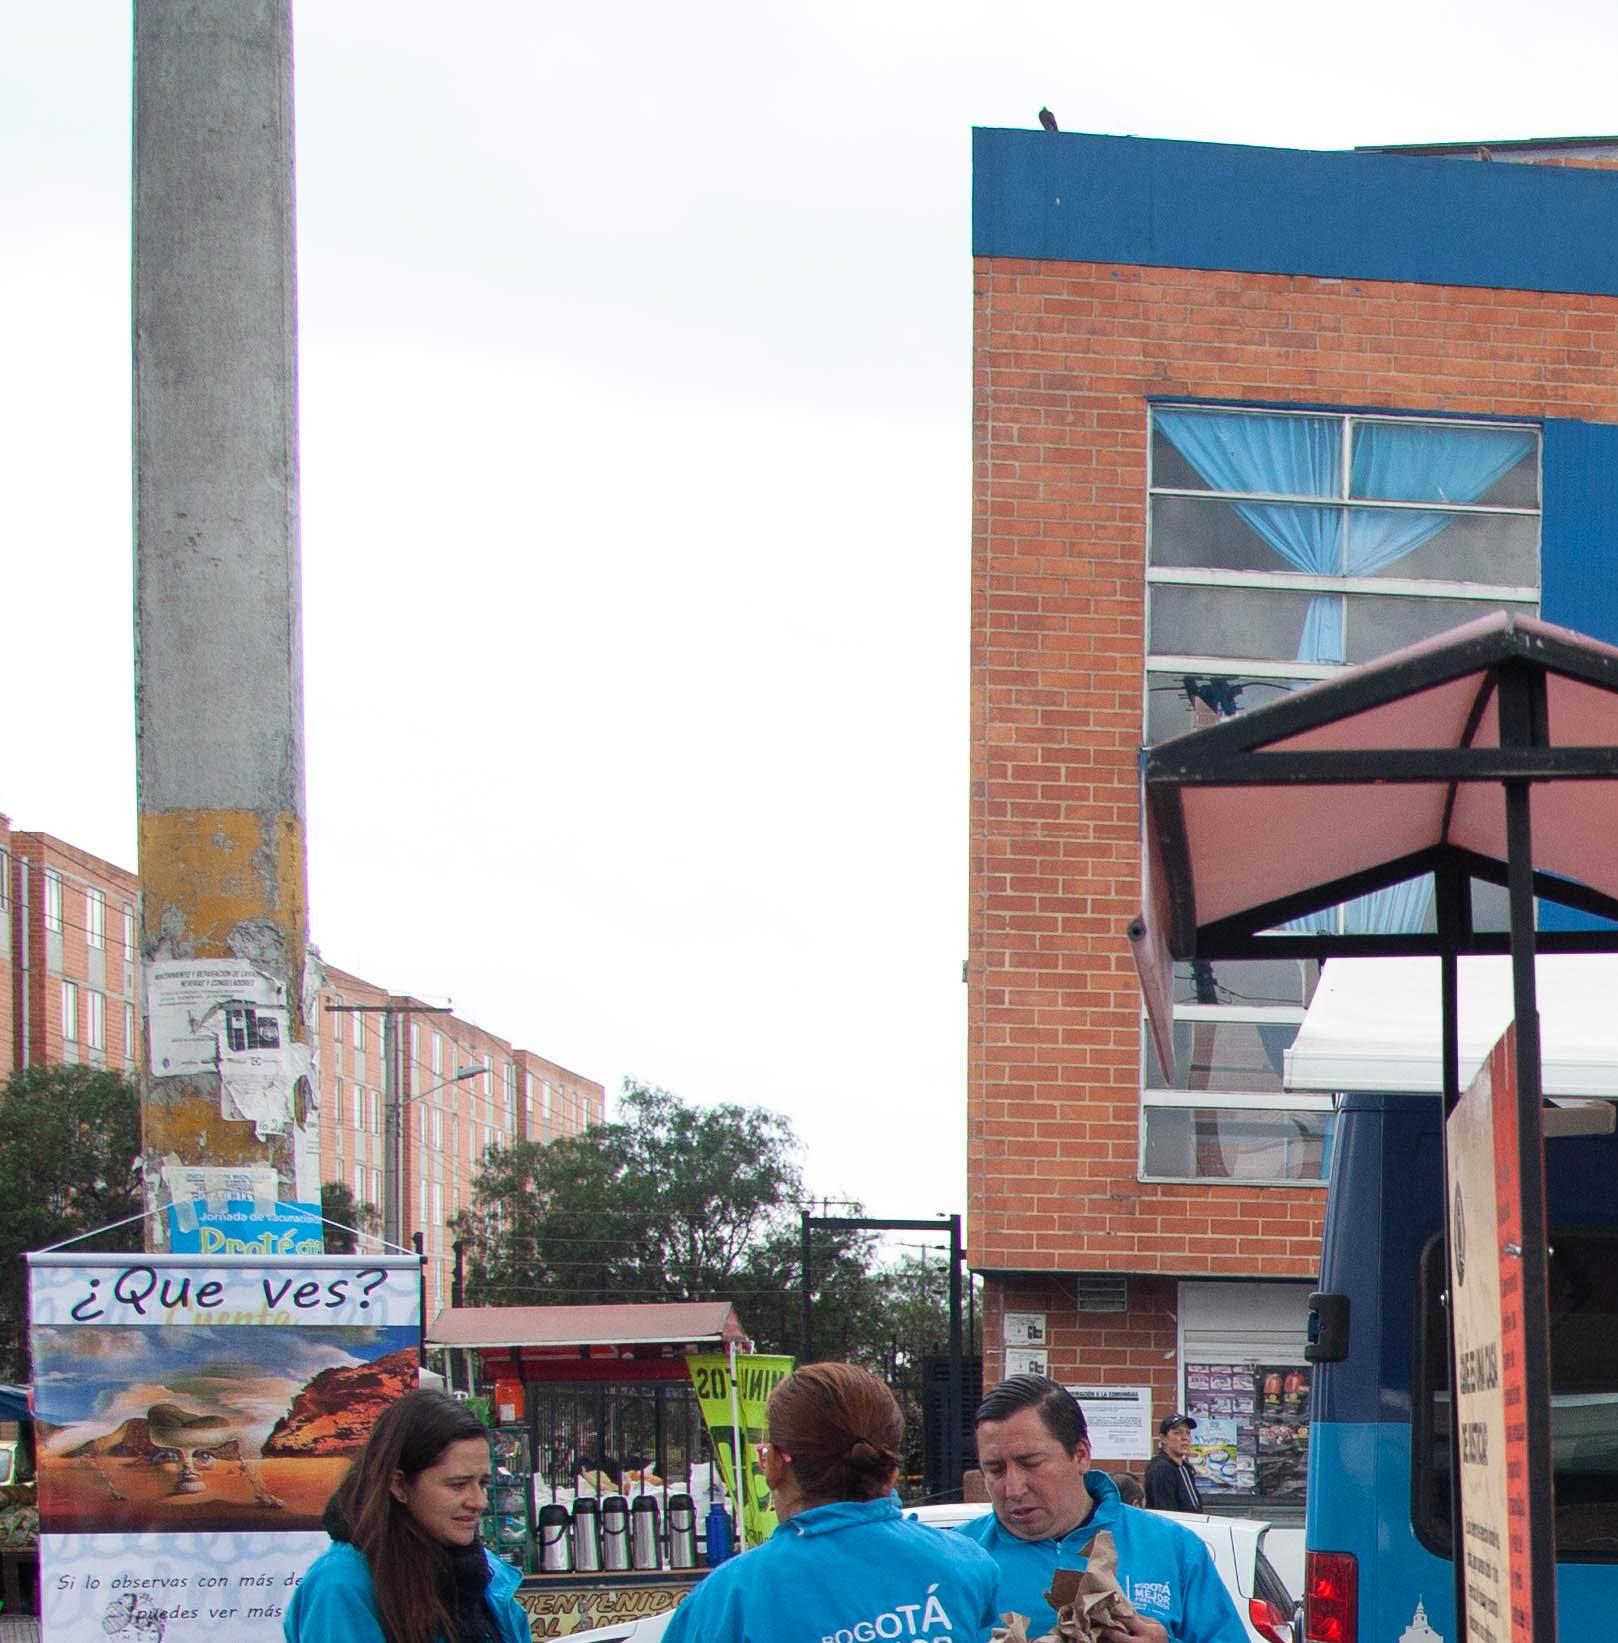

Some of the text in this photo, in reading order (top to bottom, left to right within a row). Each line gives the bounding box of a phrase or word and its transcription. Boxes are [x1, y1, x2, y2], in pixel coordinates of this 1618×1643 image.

[70, 1265, 389, 1322] ¿Que ves?
[57, 1574, 75, 1590] Si
[85, 1574, 101, 1590] lo
[111, 1574, 188, 1590] observas
[198, 1576, 228, 1587] con
[239, 1572, 273, 1587] más
[136, 1604, 283, 1621] puedes ver más
[531, 1617, 561, 1638] AL
